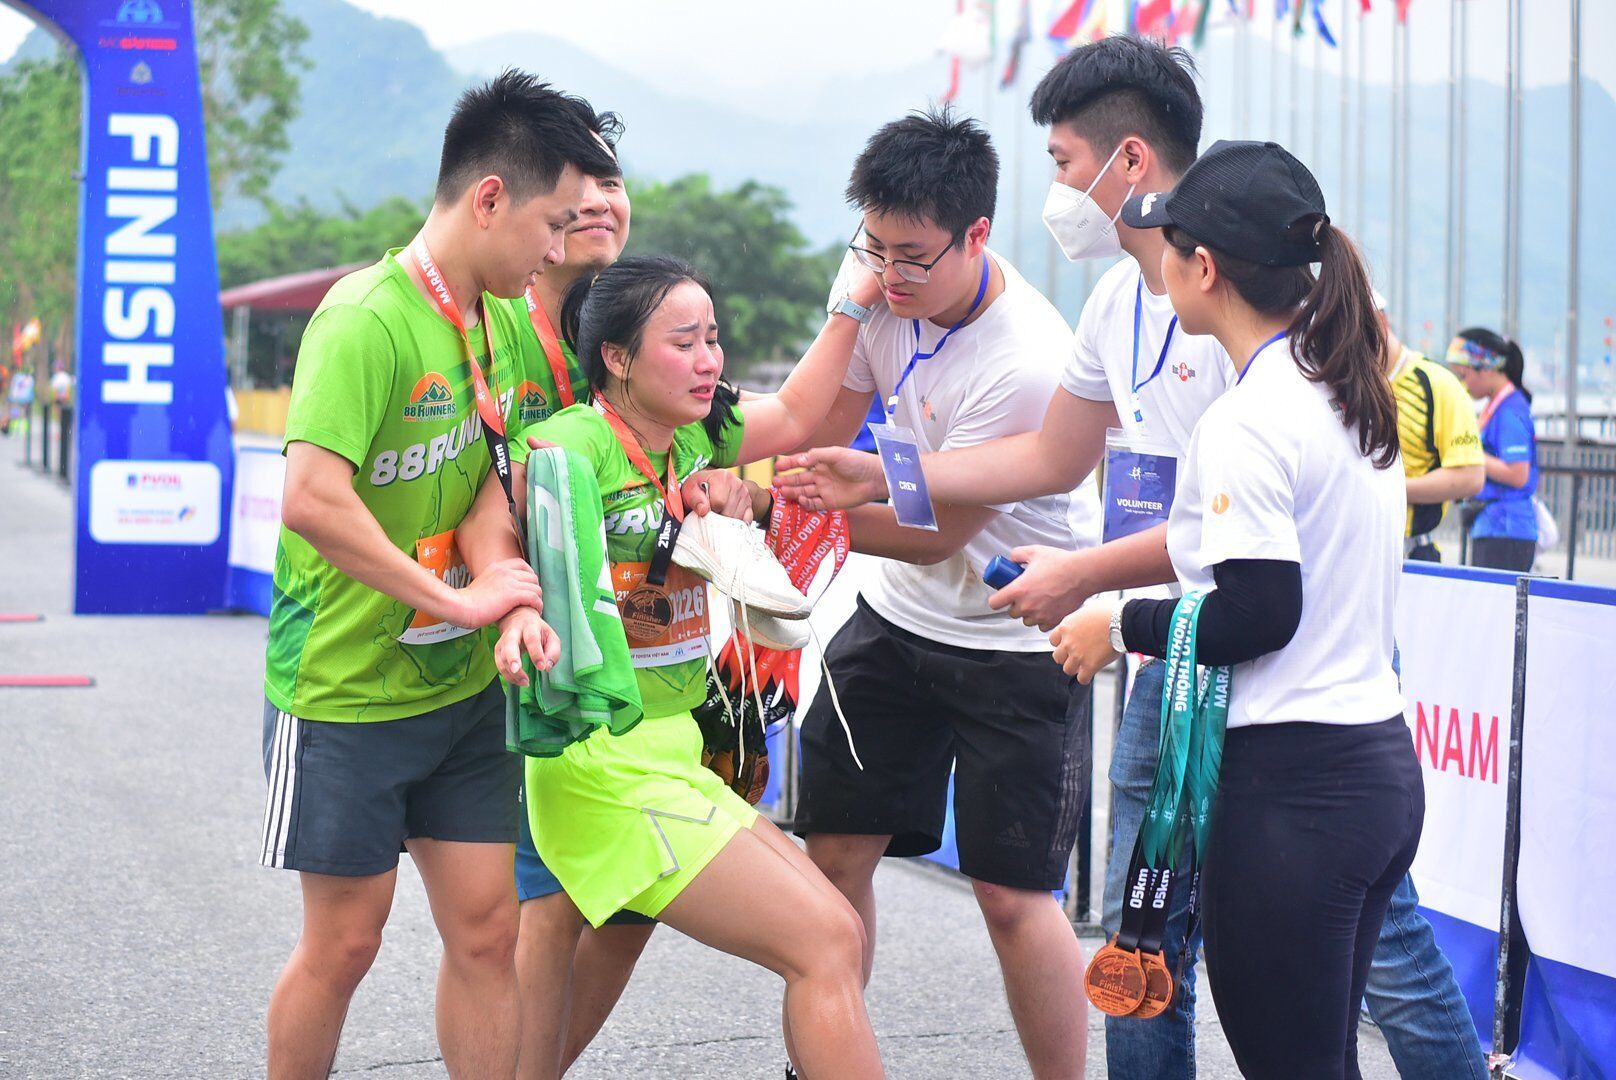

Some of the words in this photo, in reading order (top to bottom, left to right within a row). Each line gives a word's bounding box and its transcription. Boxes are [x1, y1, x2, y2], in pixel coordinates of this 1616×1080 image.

[103, 113, 180, 404] FINISH
[404, 405, 416, 418] 88
[417, 403, 456, 418] RUNNERS
[494, 443, 508, 477] 21km
[898, 480, 917, 492] CREW
[1116, 497, 1163, 511] VOLUNTEER
[657, 520, 672, 549] 21km
[770, 510, 783, 537] GIAO
[798, 516, 820, 540] GIAO
[1165, 616, 1188, 701] MARATHON
[1174, 659, 1192, 712] THÔNG
[1414, 700, 1499, 785] NAM
[1129, 868, 1149, 909] 05km
[1152, 869, 1170, 909] 05km
